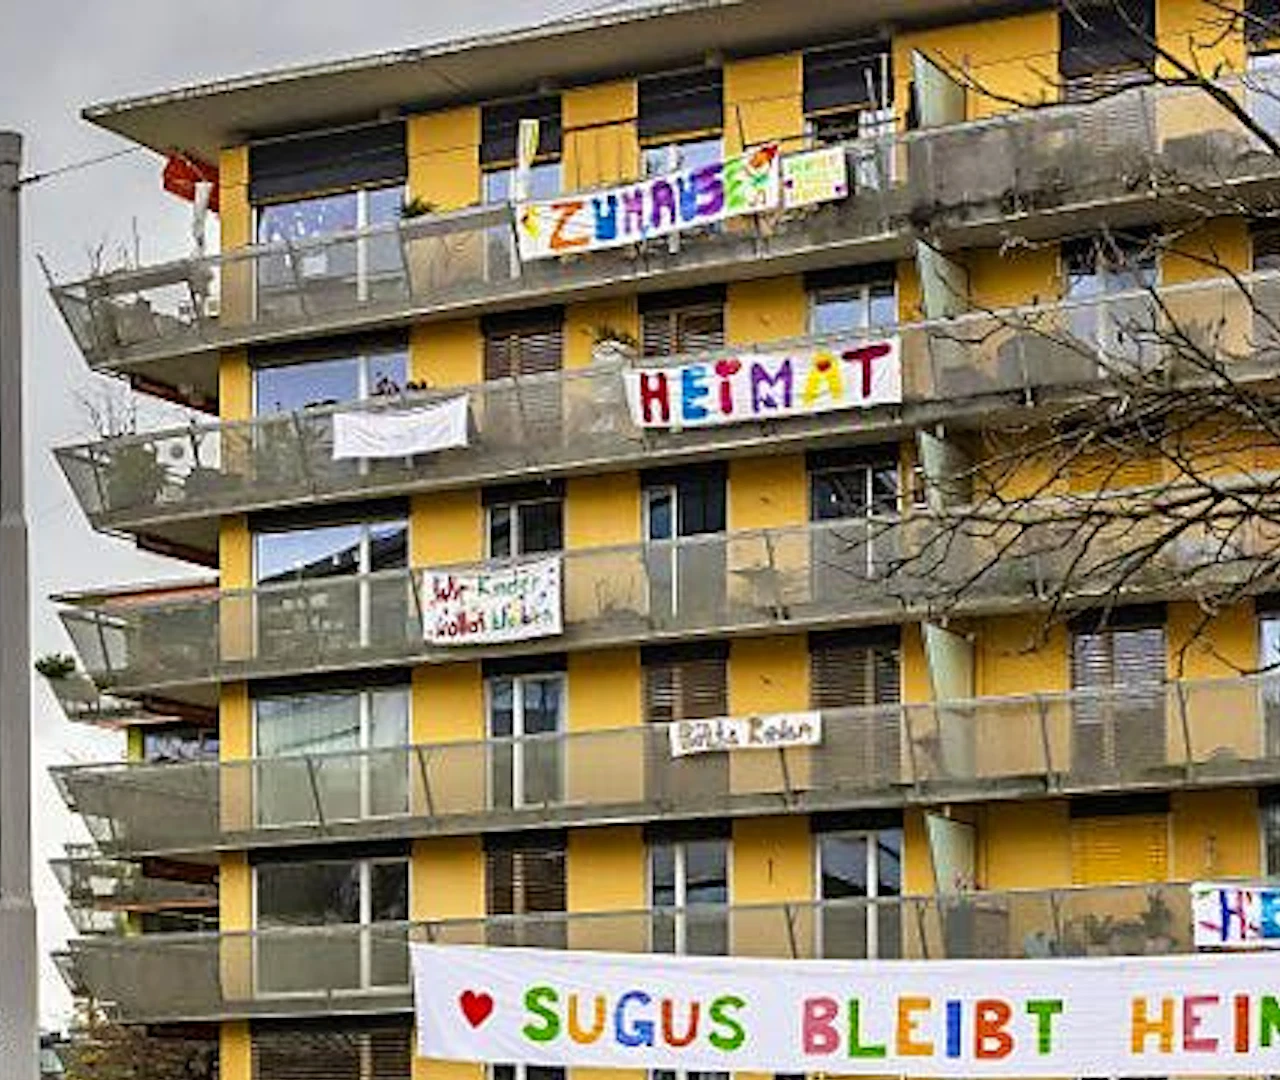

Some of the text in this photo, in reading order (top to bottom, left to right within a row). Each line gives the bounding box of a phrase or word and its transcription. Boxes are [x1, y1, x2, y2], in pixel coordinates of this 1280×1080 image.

[549, 158, 745, 248] ZUHAUSE
[640, 343, 891, 422] HEIMAT
[522, 987, 747, 1051] SUGUS
[801, 995, 1064, 1059] BLEIBT
